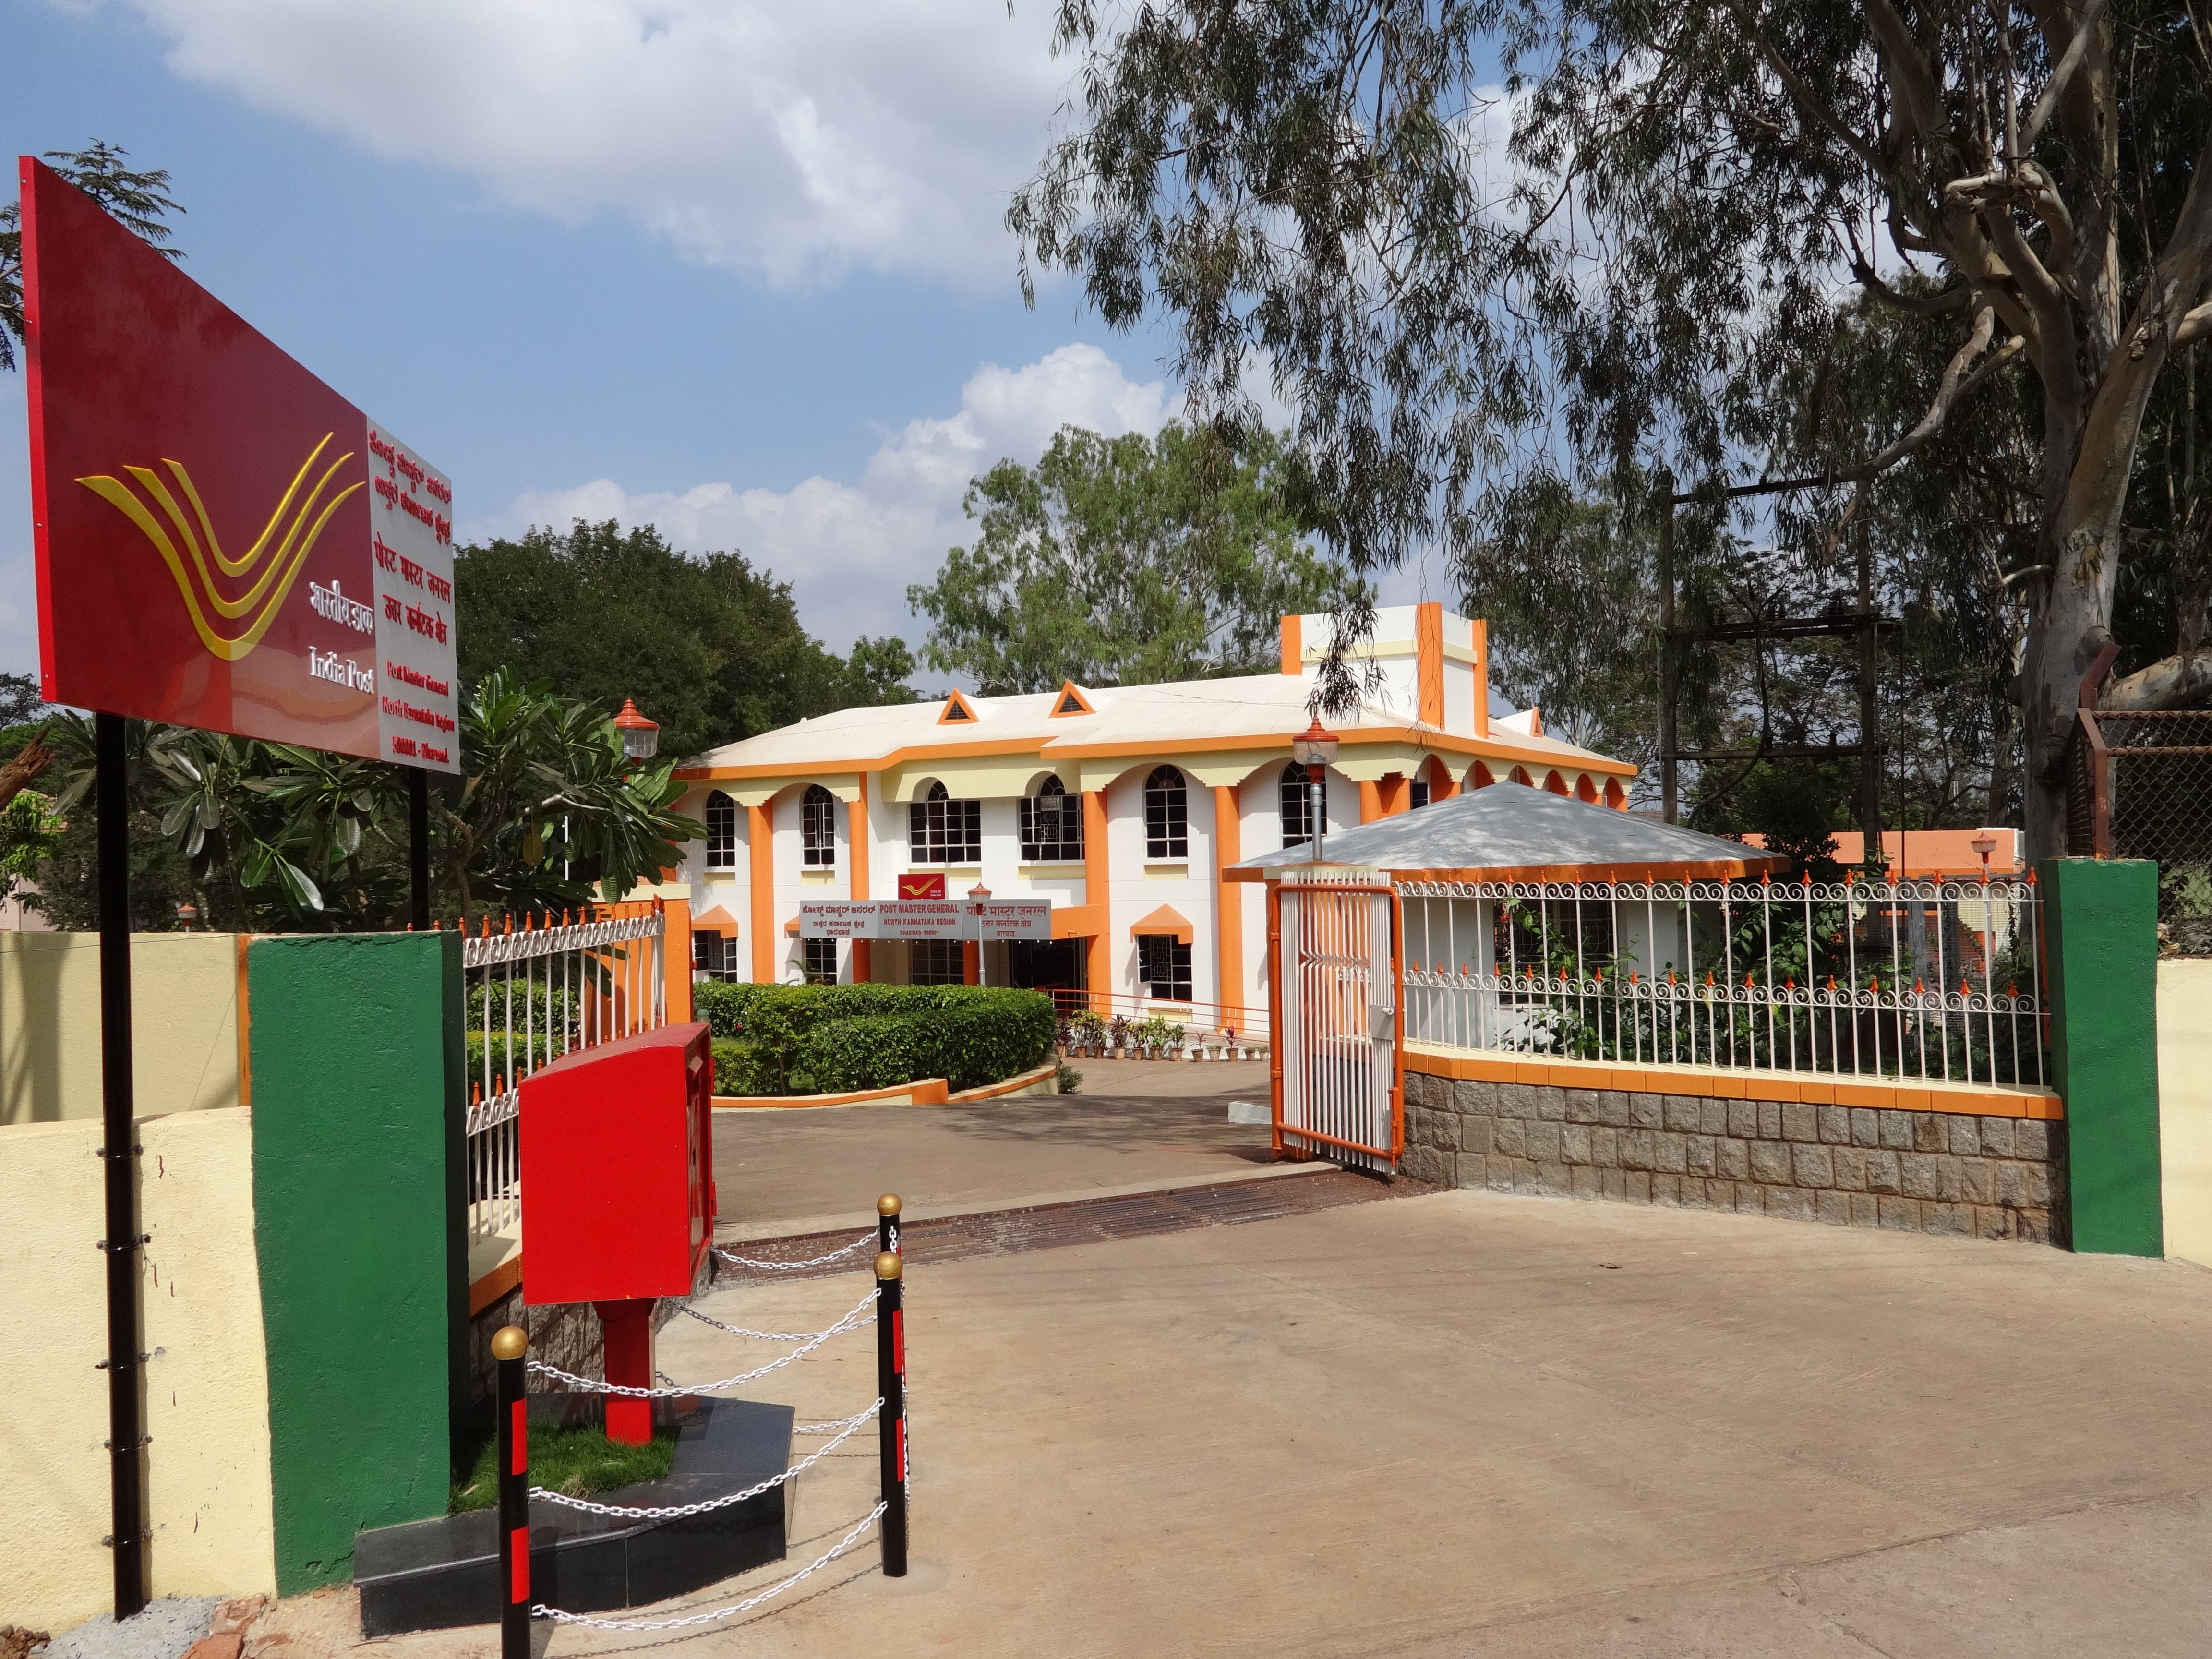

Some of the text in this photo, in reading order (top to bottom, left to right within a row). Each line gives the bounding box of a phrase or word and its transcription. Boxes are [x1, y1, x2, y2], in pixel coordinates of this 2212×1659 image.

[373, 531, 397, 572] पोस्ट
[399, 555, 423, 589] मास्टर
[309, 580, 373, 635] भारतीय डाक
[308, 646, 375, 694] India Post
[387, 660, 449, 697] Post Master General
[382, 696, 404, 717] North
[880, 904, 959, 913] POST MASTER GENERAL
[989, 906, 1015, 916] मास्टर
[1017, 906, 1047, 917] जनरल
